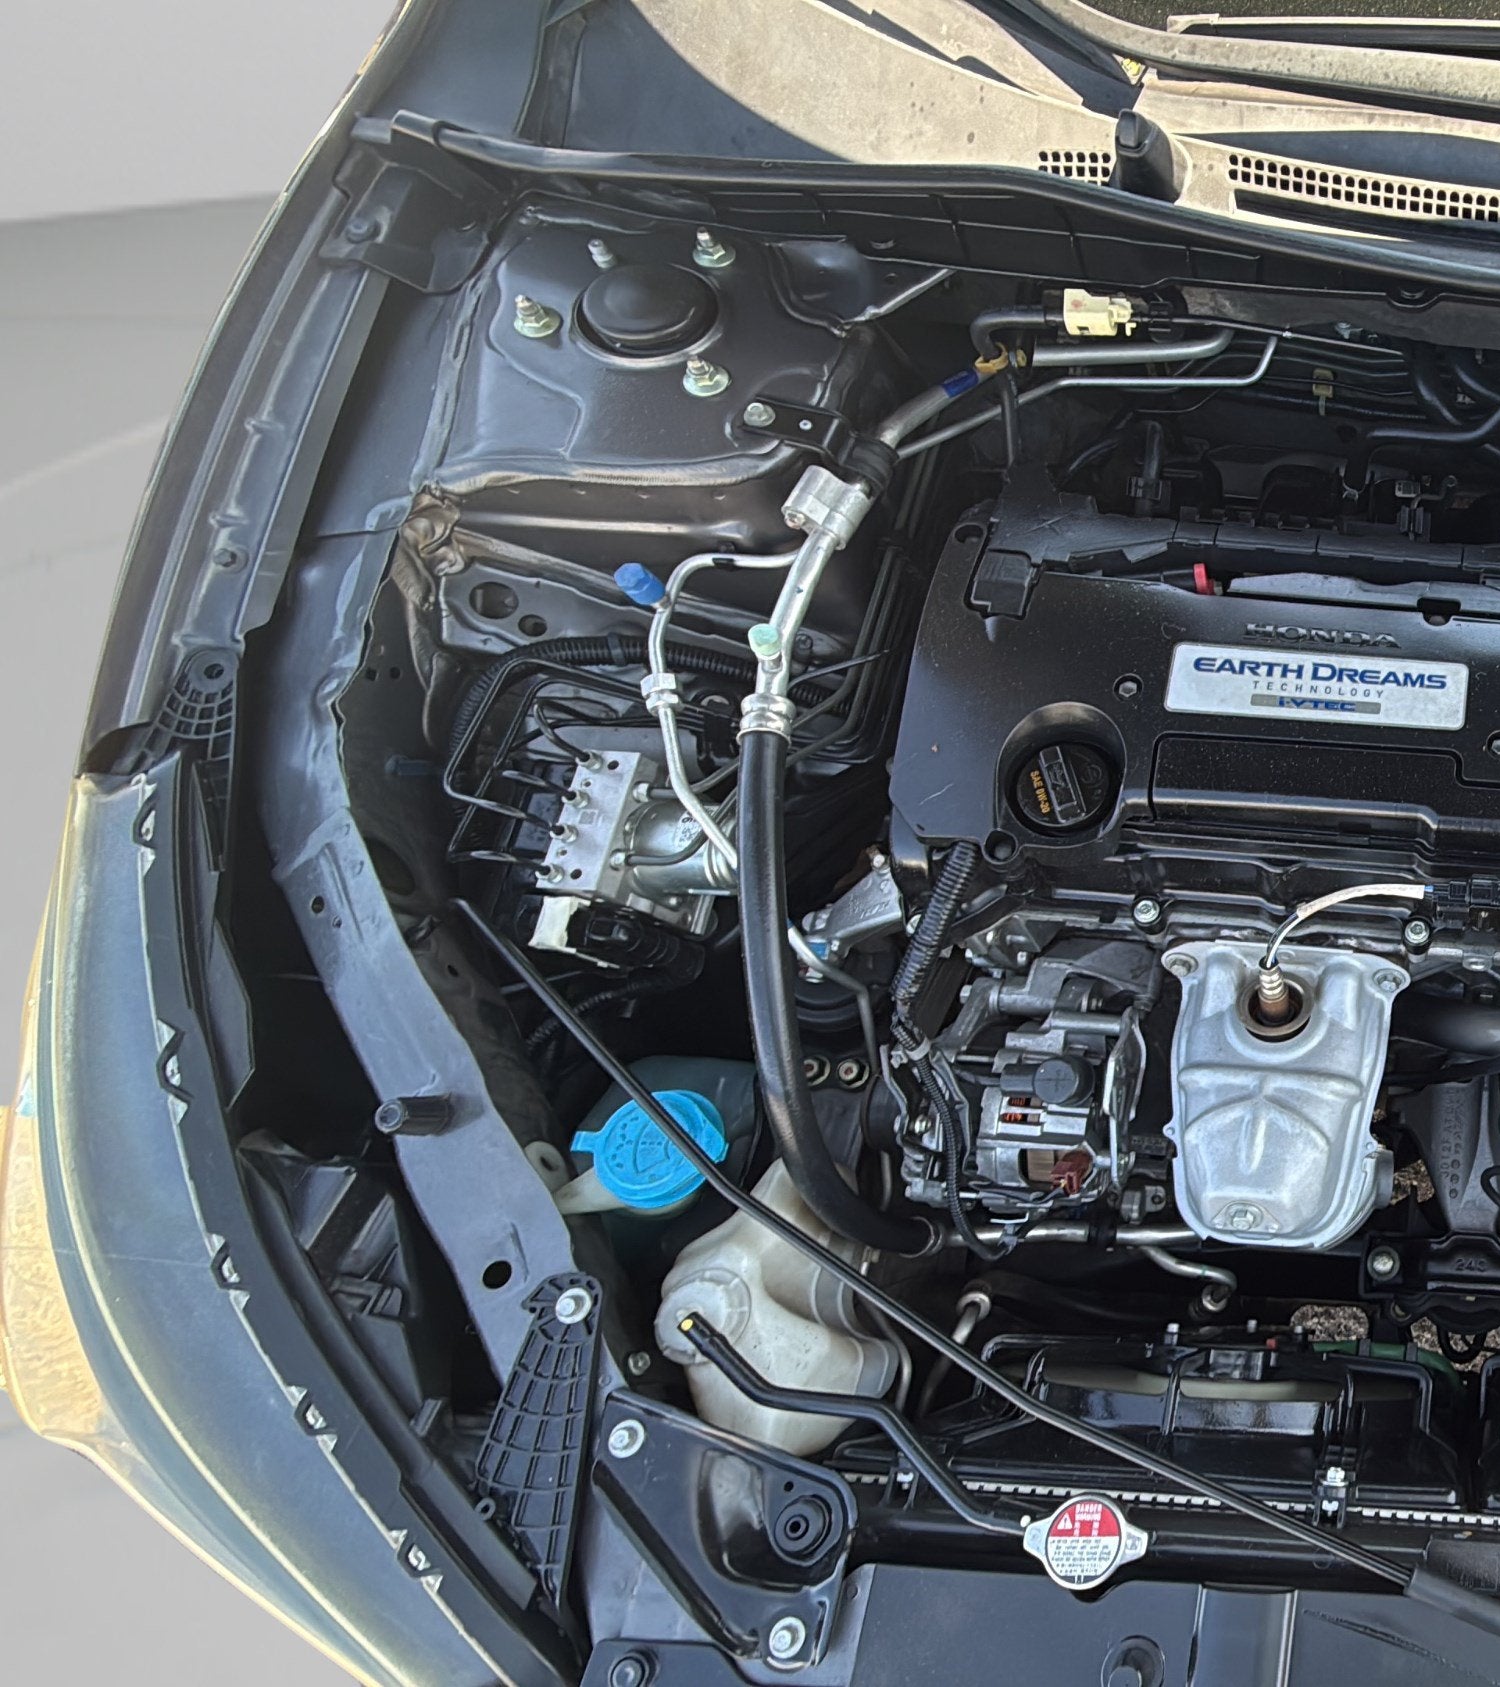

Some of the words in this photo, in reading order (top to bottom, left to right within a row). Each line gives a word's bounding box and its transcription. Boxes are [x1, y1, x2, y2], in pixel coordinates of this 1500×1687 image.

[1242, 622, 1402, 649] HONDA
[1193, 656, 1304, 681] EARTH
[1311, 662, 1448, 690] DREAMS
[1251, 679, 1385, 700] TECHNOLOGY
[1277, 695, 1357, 712] i-VTEC
[1030, 770, 1043, 788] SAE
[1035, 788, 1050, 813] 0W-20
